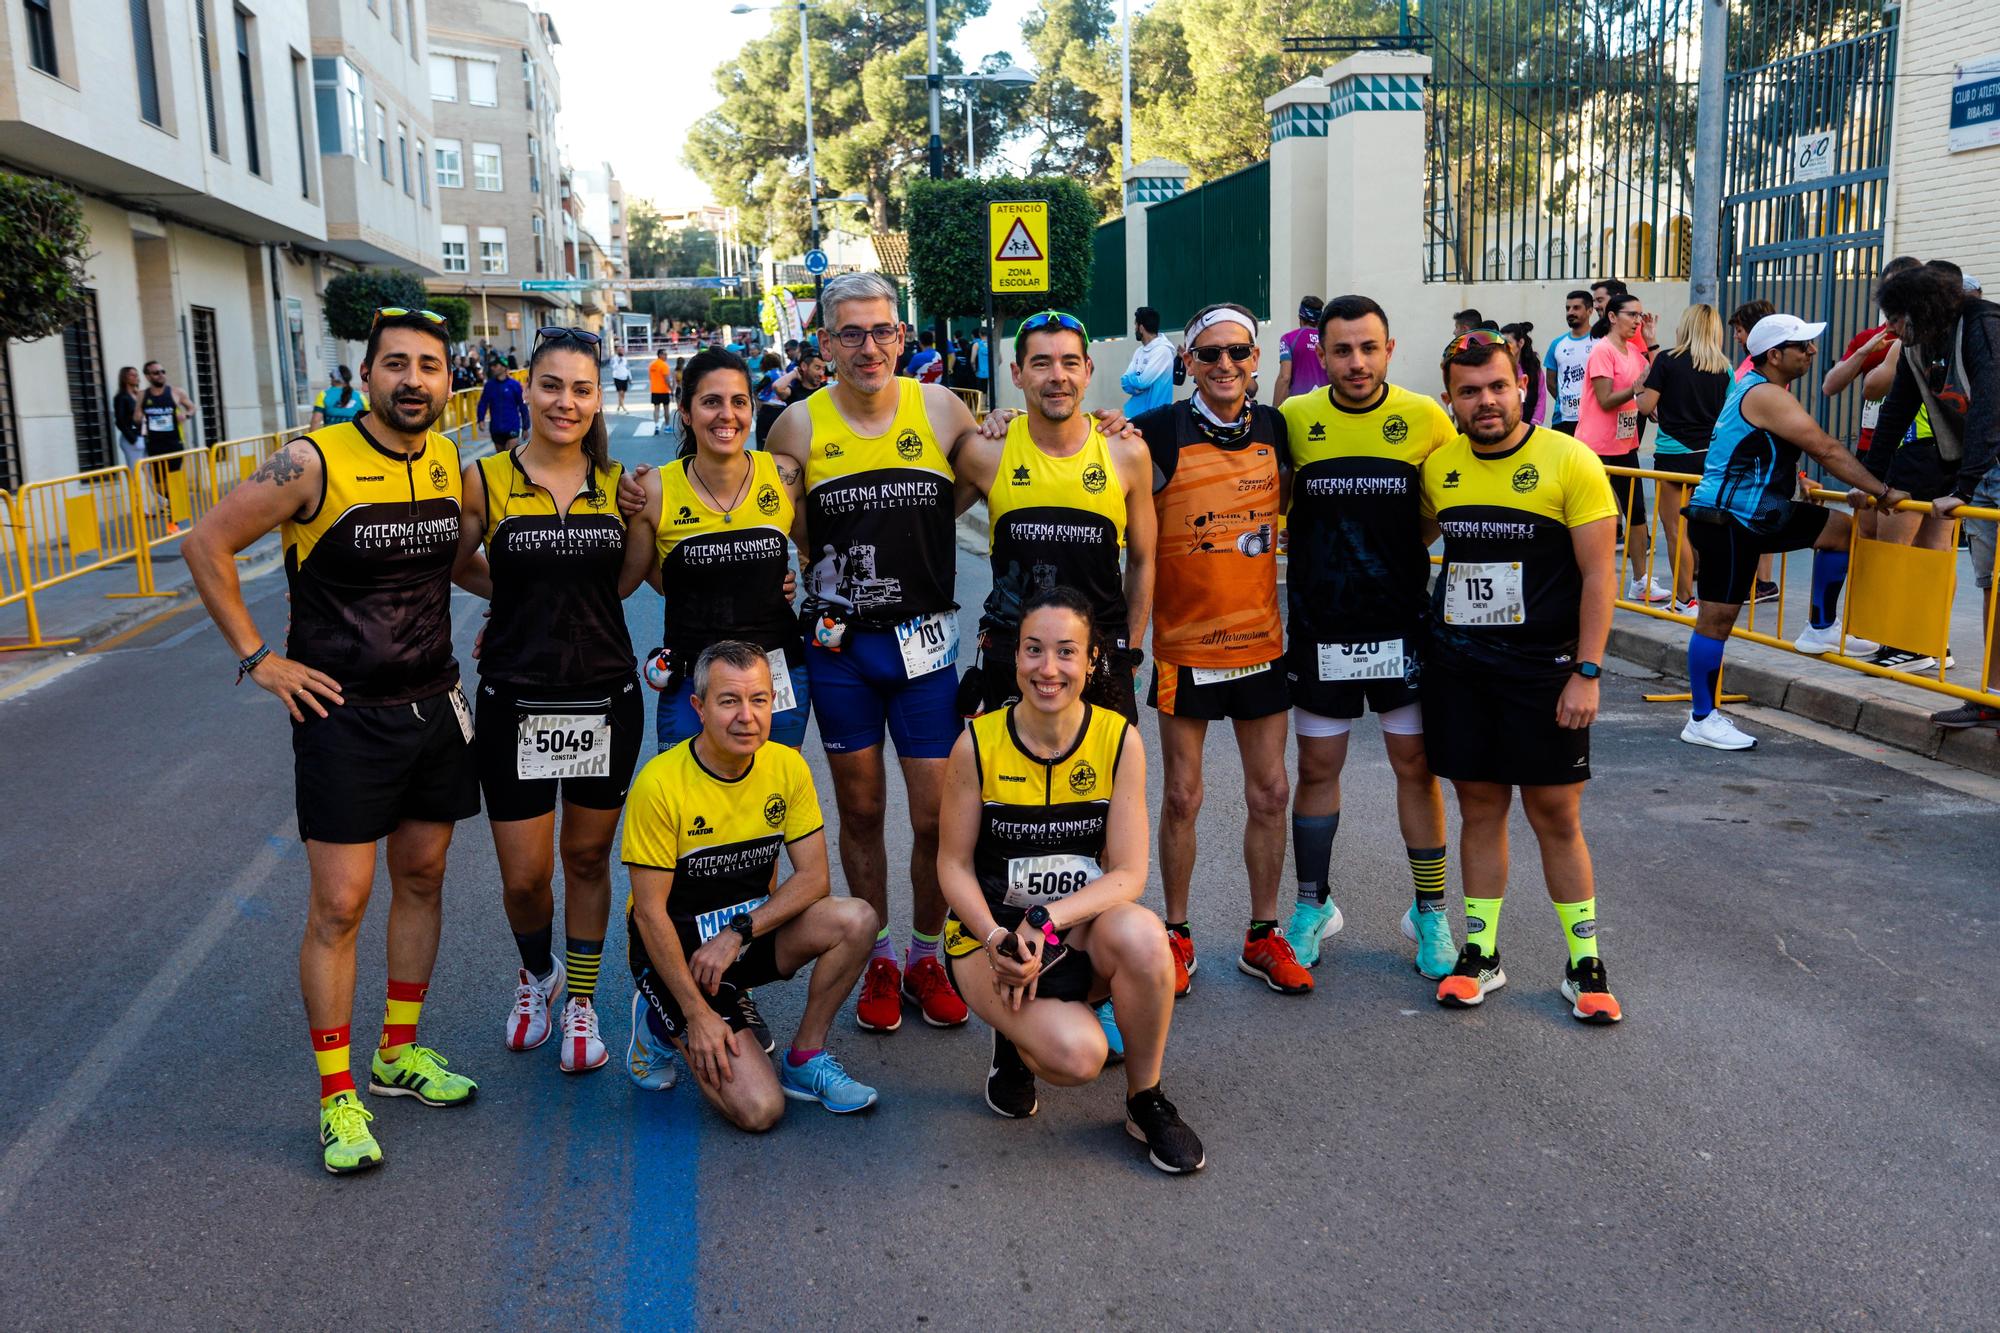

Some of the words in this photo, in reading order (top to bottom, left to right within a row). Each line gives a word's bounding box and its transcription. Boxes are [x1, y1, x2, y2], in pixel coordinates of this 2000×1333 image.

[1955, 90, 1971, 104] CLUB
[1008, 268, 1032, 276] ZONA
[999, 279, 1040, 287] ESCOLAR
[1306, 478, 1353, 490] PATERNA
[1356, 477, 1407, 489] RUNNERS
[819, 485, 877, 507] PATERNA
[881, 482, 938, 499] RUNNERS
[1307, 488, 1334, 496] CLUB
[824, 503, 856, 515] CLUB
[863, 497, 937, 511] ATLETISMO
[354, 523, 414, 539] PATERNA
[417, 516, 459, 535] RUNNERS
[673, 516, 700, 526] VIATOR
[1010, 523, 1055, 535] PATERNA
[1056, 524, 1104, 538] RUNNERS
[1466, 531, 1535, 540] ATLETISMO
[1482, 522, 1535, 535] RUNNERS
[354, 539, 392, 549] CLUB
[400, 531, 460, 547] ATLETISMO
[508, 529, 565, 544] PATERNA
[568, 528, 621, 541] RUNNERS
[1040, 533, 1103, 544] ATLETISMO
[404, 546, 432, 555] TRAIL
[508, 541, 541, 552] CLUB
[683, 542, 731, 558] PATERNA
[734, 537, 781, 554] RUNNERS
[684, 557, 713, 565] CLUB
[719, 549, 782, 563] ATLETISMO
[1465, 578, 1494, 601] 113
[1341, 642, 1380, 656] 920
[536, 729, 594, 753] 5049
[551, 753, 577, 761] CONSTAN
[687, 827, 714, 837] VIATOR
[991, 818, 1047, 834] PATERNA
[1049, 816, 1103, 832] RUNNERS
[688, 852, 738, 869] PATERNA
[687, 868, 718, 877] CLUB
[1027, 870, 1088, 896] 5068
[642, 979, 675, 1031] WONG
